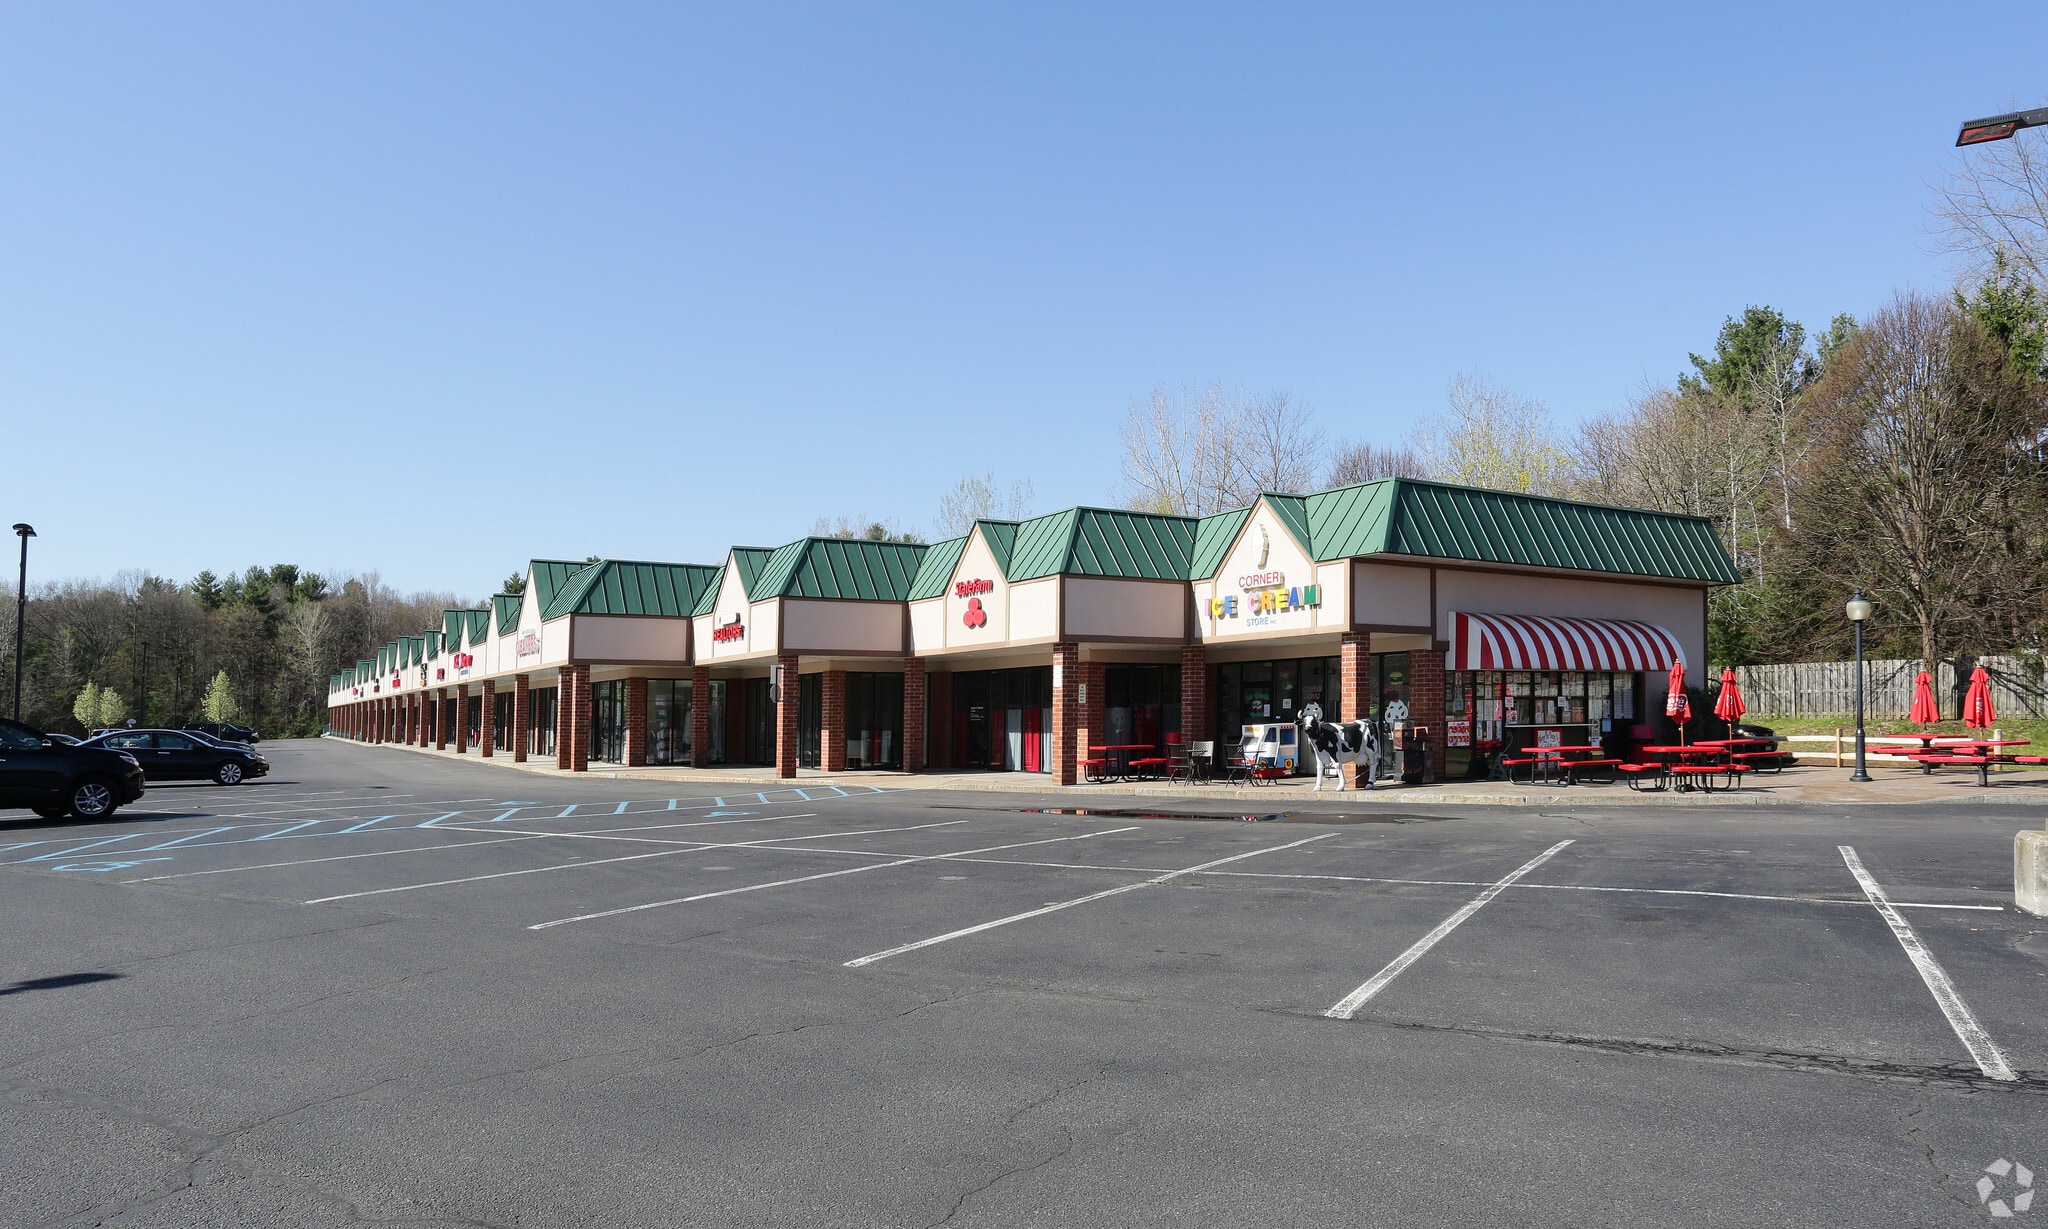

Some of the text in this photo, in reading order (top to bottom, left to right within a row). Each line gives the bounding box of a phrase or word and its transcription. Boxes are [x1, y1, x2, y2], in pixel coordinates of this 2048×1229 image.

[1239, 572, 1279, 588] CORNER
[1205, 584, 1320, 617] ICE CREAM
[1246, 617, 1269, 627] STORE
